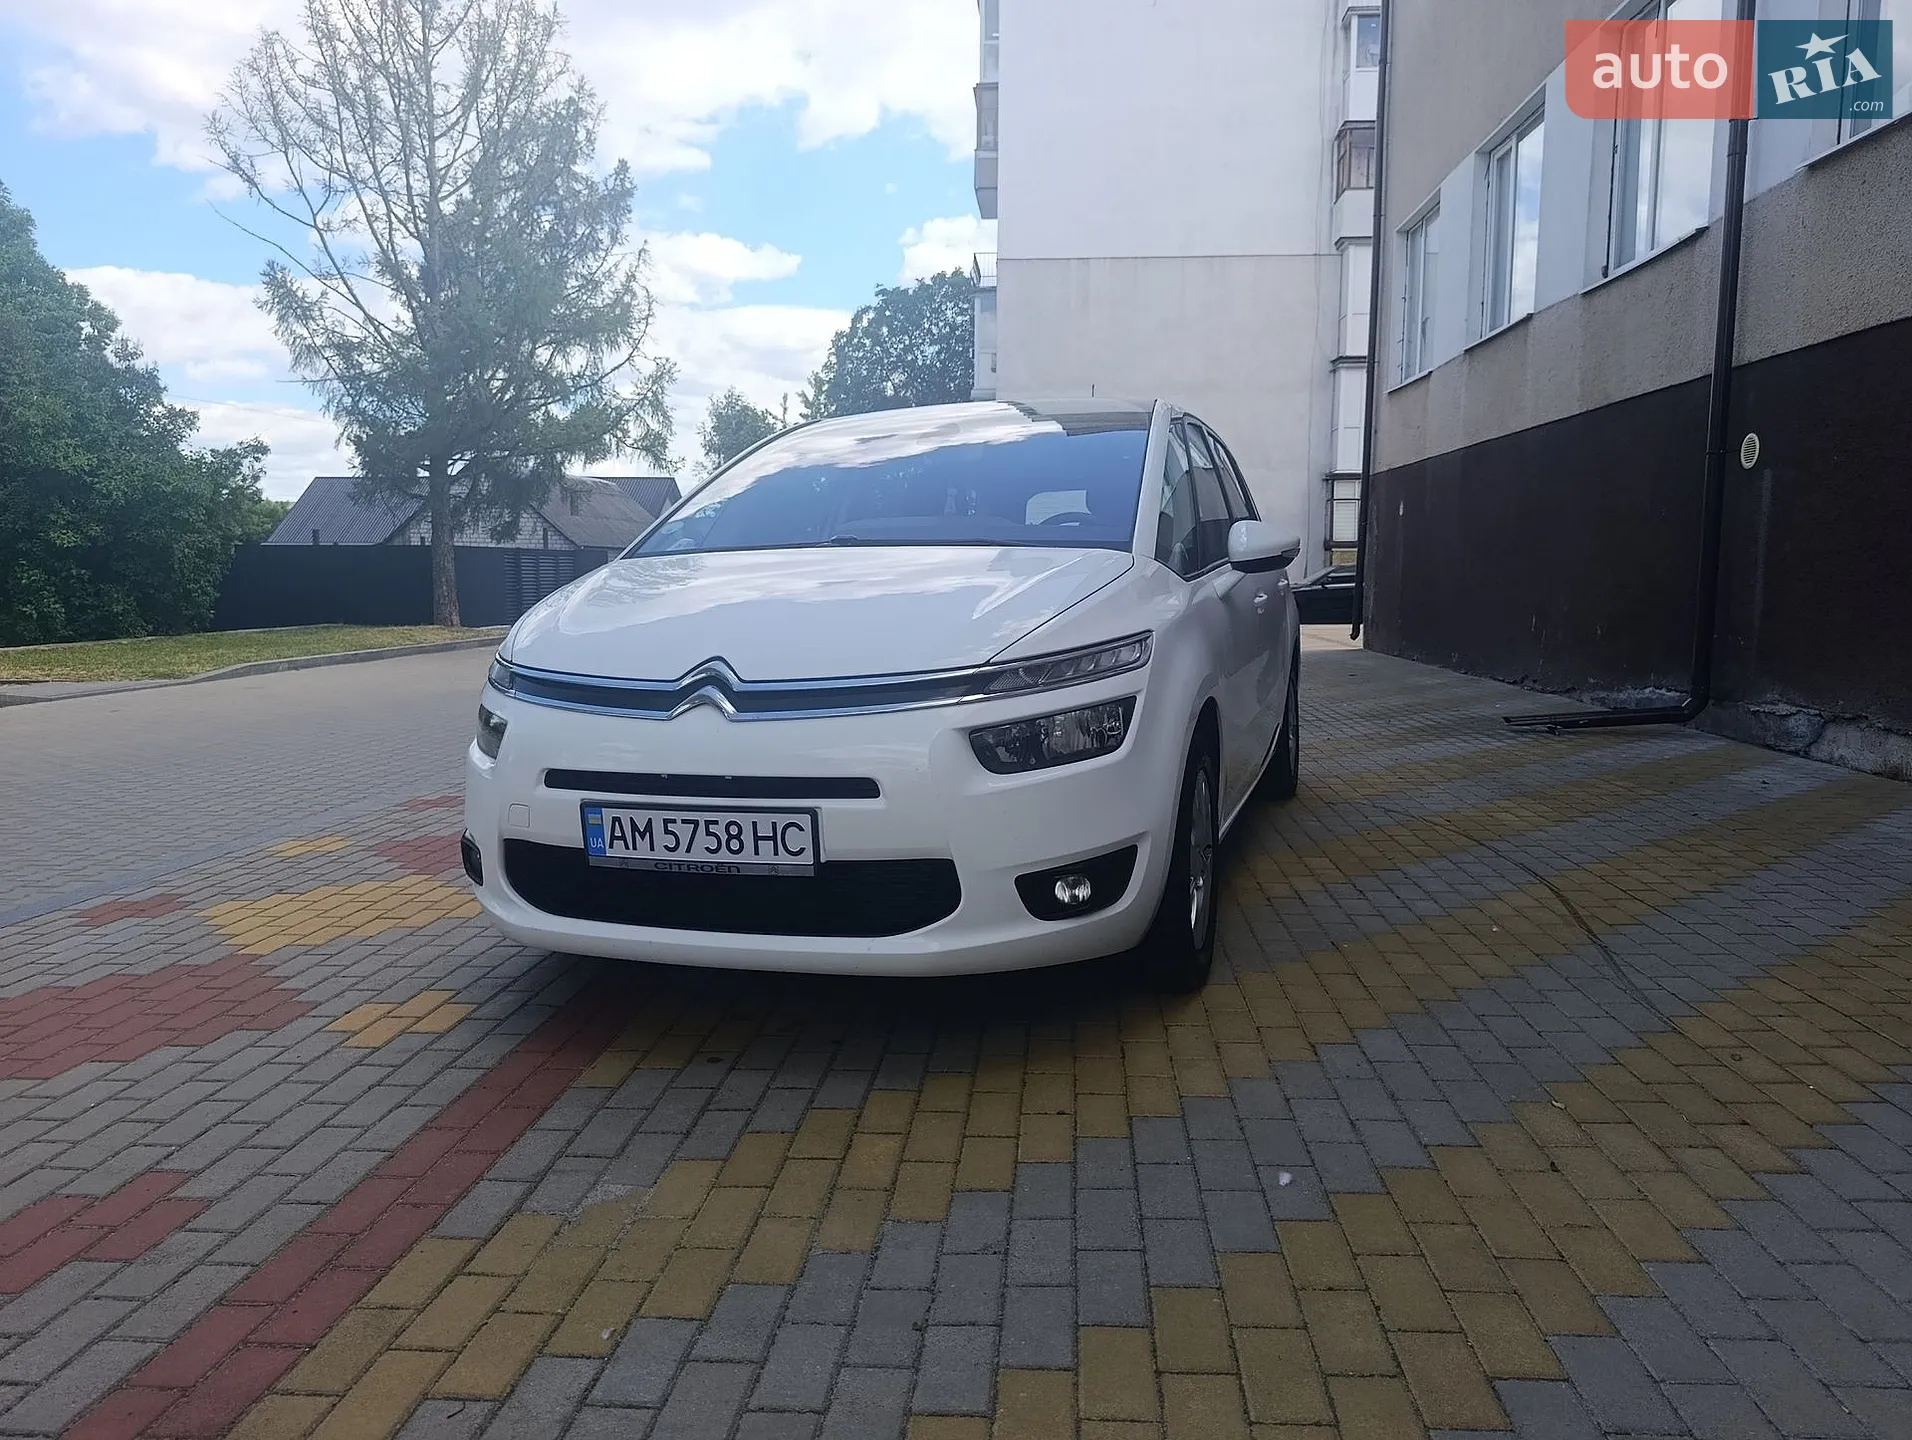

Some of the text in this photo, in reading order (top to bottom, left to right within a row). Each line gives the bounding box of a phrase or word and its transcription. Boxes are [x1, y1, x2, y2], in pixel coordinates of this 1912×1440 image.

[589, 837, 605, 849] UA
[608, 815, 807, 857] AM 5758 HC
